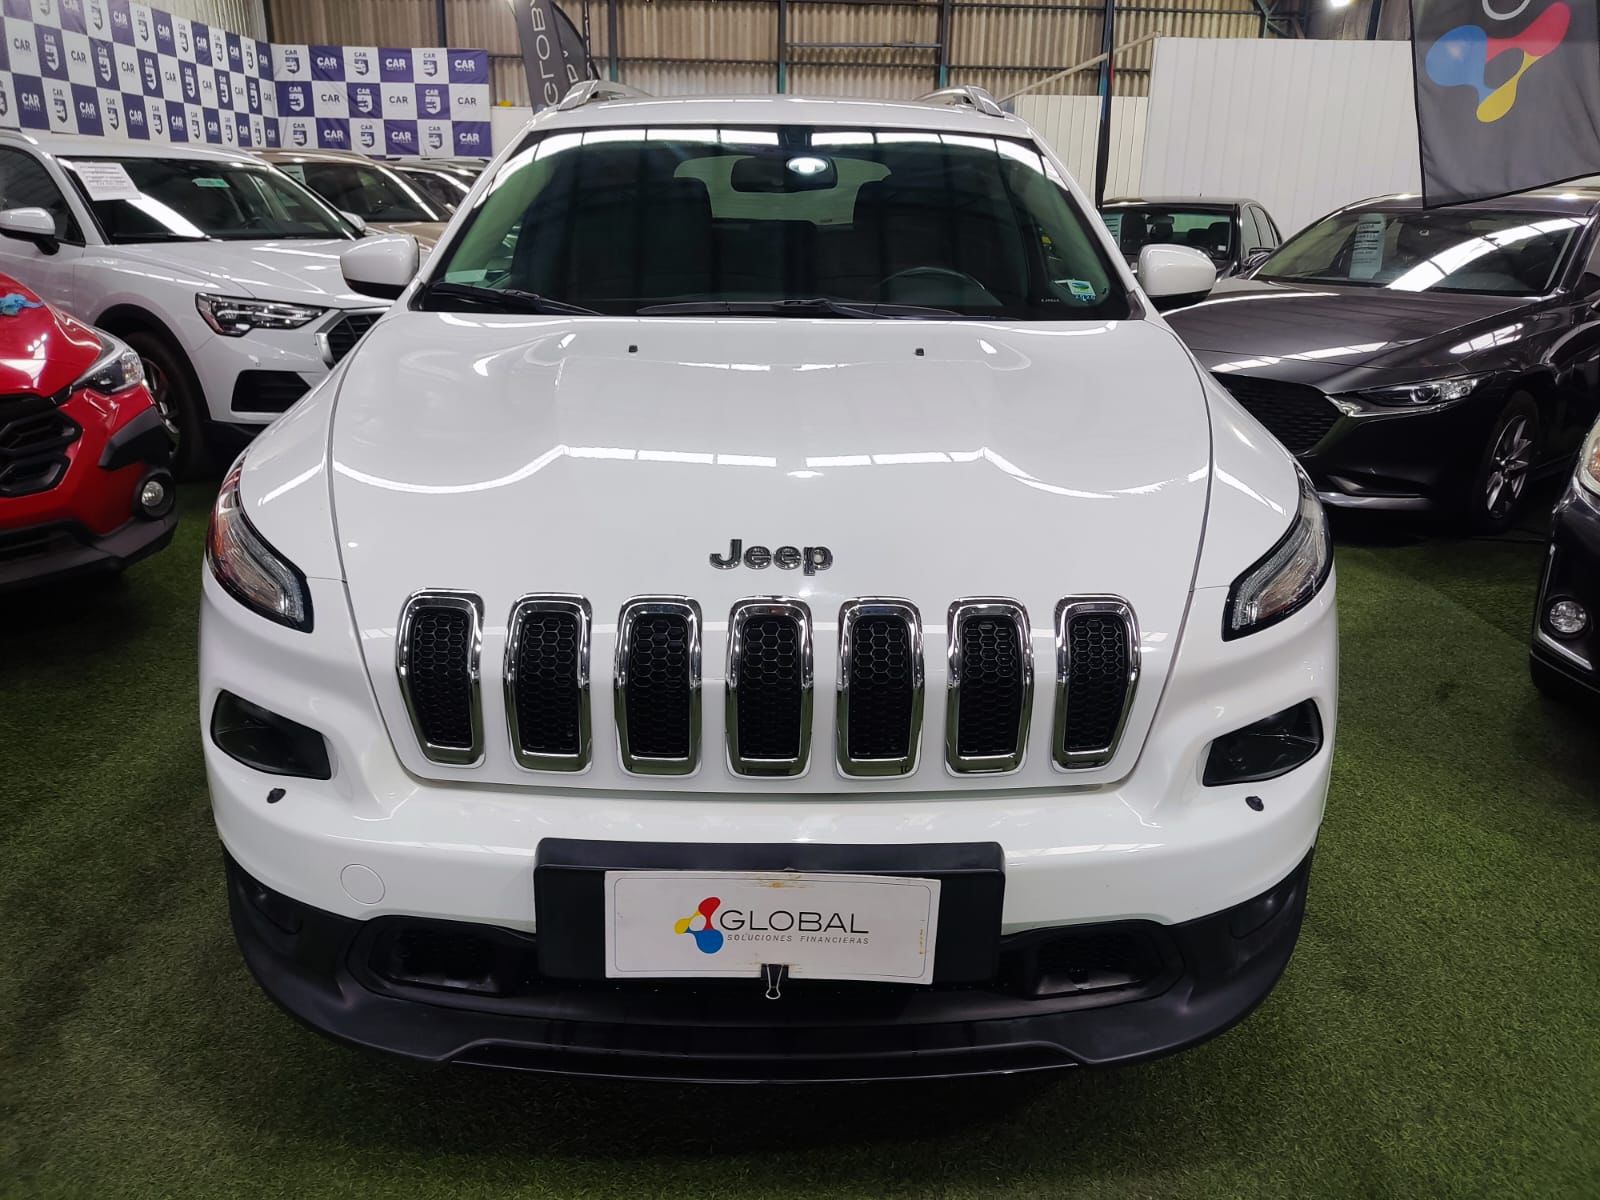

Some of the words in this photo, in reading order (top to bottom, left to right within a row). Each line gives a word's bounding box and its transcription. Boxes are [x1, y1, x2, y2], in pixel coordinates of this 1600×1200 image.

[113, 10, 128, 25] CAR
[158, 24, 170, 37] CAR
[14, 38, 31, 52] CAR
[71, 50, 87, 64] CAR
[317, 57, 338, 67] CAR
[122, 62, 135, 74] CAR
[386, 58, 406, 68] CAR
[454, 60, 475, 69] CAR
[165, 72, 176, 82] CAR
[22, 92, 40, 107] CAR
[320, 94, 340, 103] CAR
[389, 96, 408, 104] CAR
[458, 97, 477, 105] CAR
[80, 102, 96, 116] CAR
[130, 110, 143, 122] CAR
[172, 116, 183, 127] CAR
[324, 130, 344, 139] CAR
[392, 132, 412, 141] CAR
[460, 133, 480, 142] CAR
[709, 538, 833, 576] Jeep
[720, 910, 869, 934] GLOBAL
[727, 934, 793, 942] SOLUCIONES
[800, 936, 870, 945] FINANCIERAS
